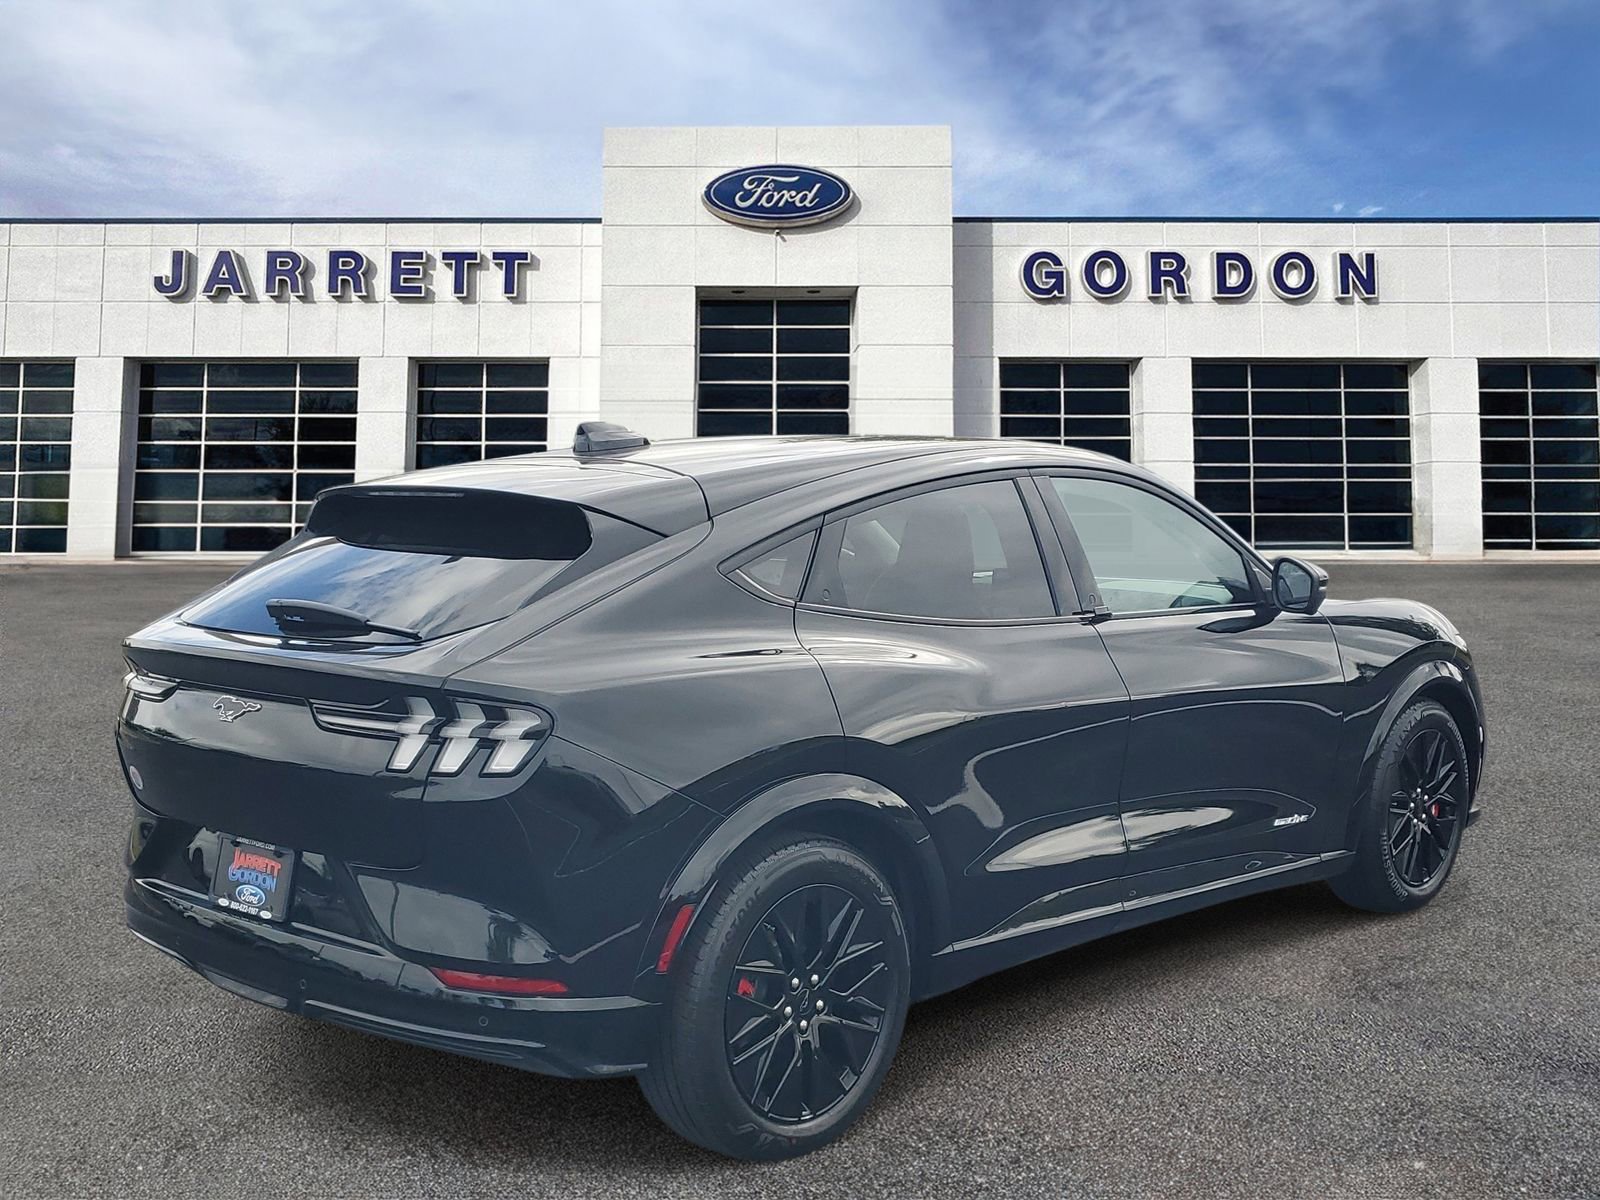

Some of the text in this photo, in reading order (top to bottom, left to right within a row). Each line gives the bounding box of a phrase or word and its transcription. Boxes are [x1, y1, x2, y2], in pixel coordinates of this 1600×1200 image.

[735, 174, 822, 208] Ford
[153, 248, 532, 298] JARRETT
[1020, 249, 1379, 300] GORDON
[232, 847, 282, 877] JARRETT
[228, 865, 277, 892] GORDON
[240, 887, 261, 904] Ford
